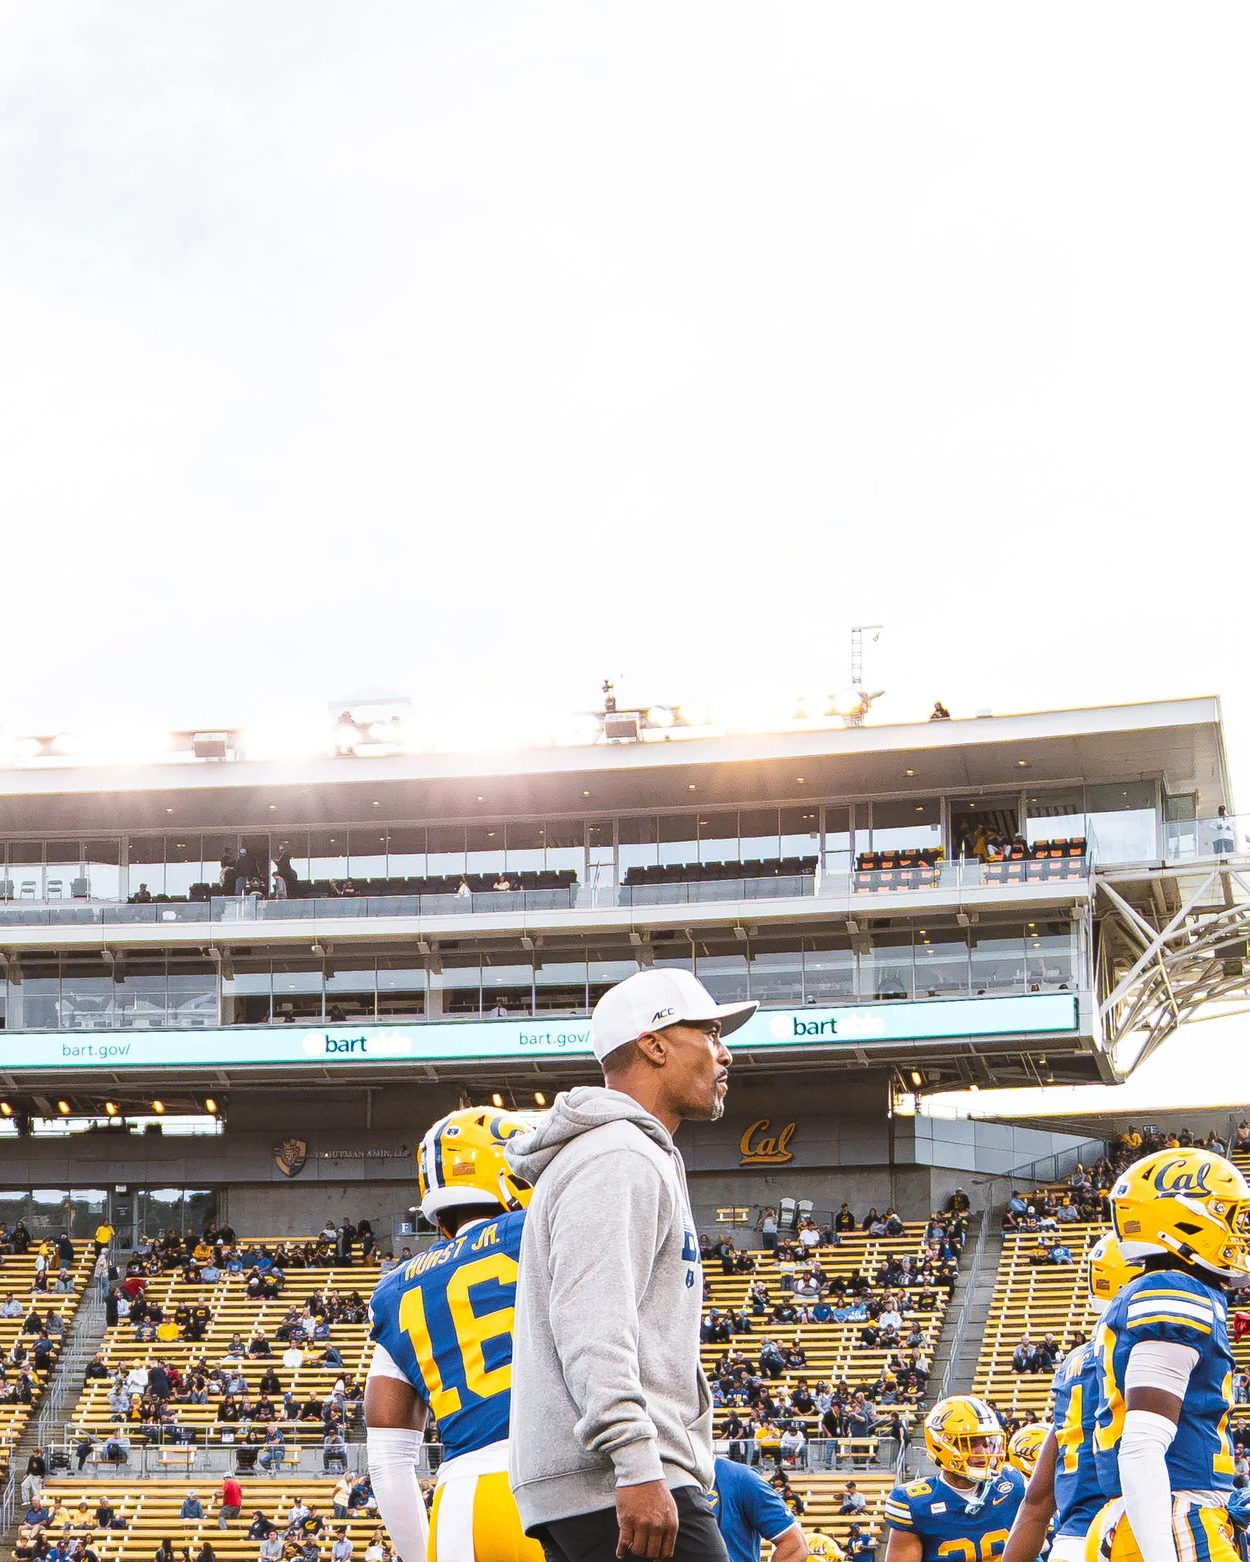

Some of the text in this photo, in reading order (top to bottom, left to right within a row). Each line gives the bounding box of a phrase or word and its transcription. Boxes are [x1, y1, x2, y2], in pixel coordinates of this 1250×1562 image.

[651, 1007, 676, 1023] ACC
[61, 1042, 132, 1058] bart.gov/
[519, 1029, 590, 1047] bart.gov/
[739, 1119, 796, 1166] Cal
[1154, 1160, 1212, 1200] Cal
[405, 1223, 500, 1282] HURST JR.
[399, 1252, 519, 1422] 16
